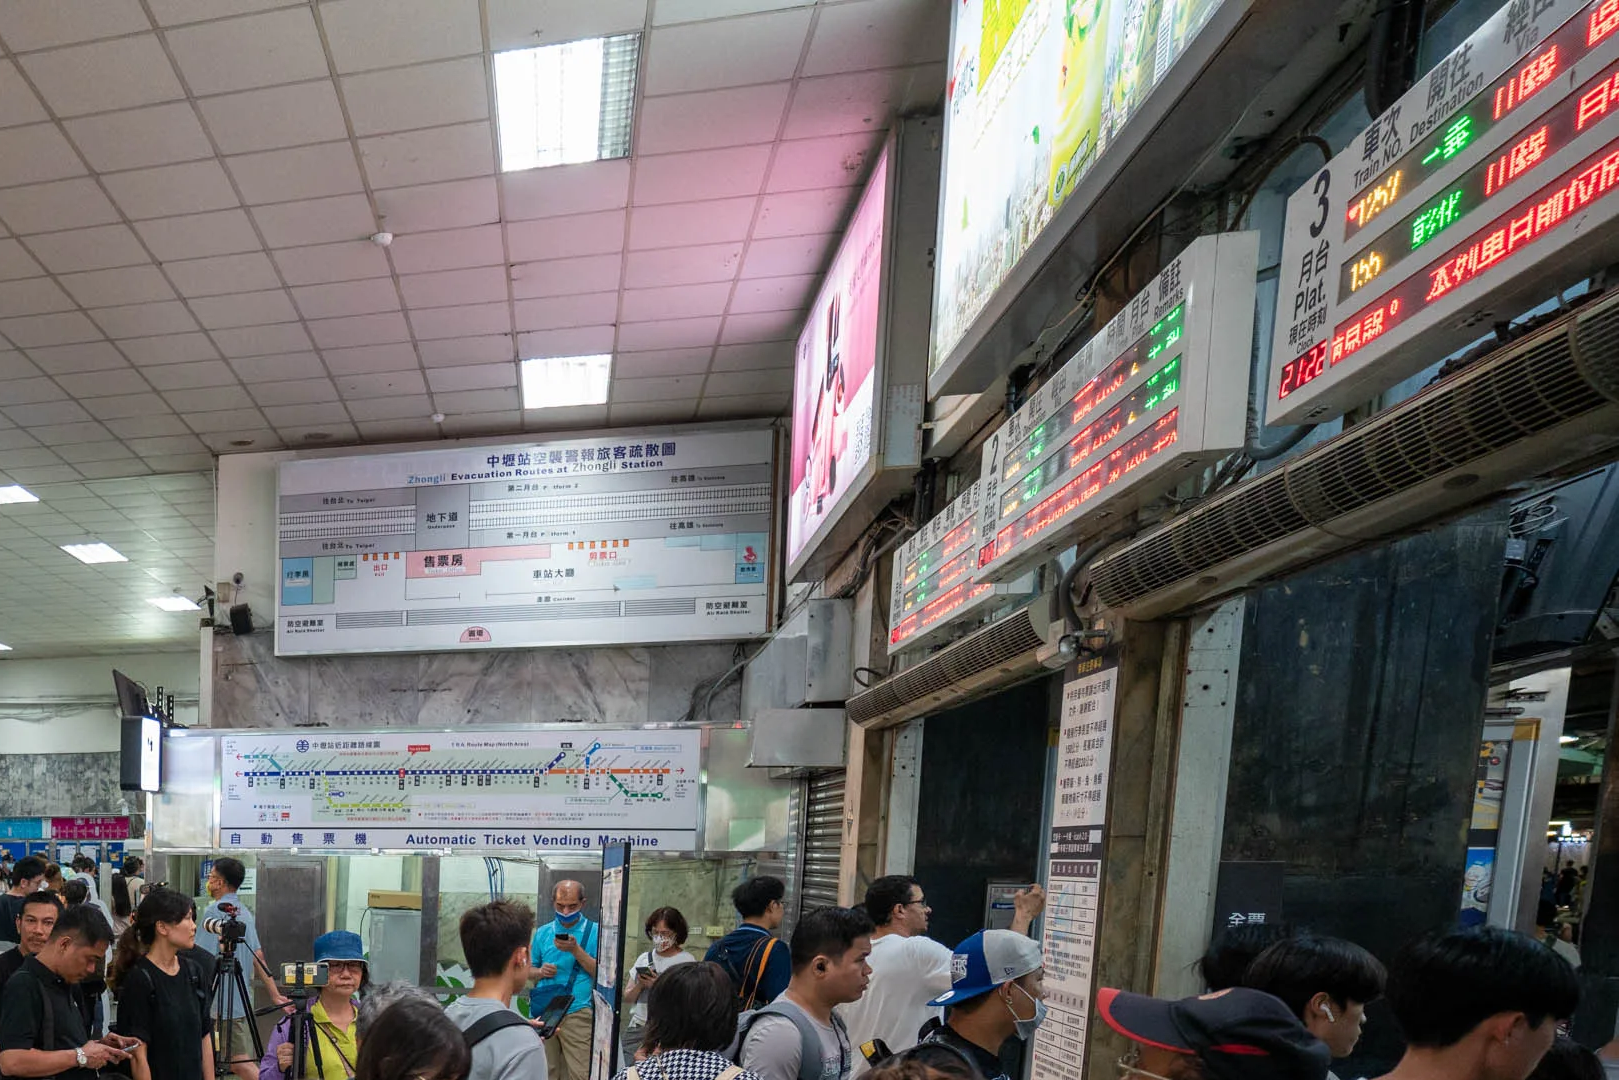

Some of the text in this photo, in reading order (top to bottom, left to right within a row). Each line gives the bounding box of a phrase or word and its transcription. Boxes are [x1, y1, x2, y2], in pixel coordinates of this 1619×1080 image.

[1516, 26, 1539, 55] Via
[1425, 43, 1472, 111] 開往
[1410, 72, 1483, 143] Destination
[1362, 104, 1401, 161] 車次
[1354, 139, 1403, 188] Train NO.
[1309, 169, 1332, 239] 3
[1300, 239, 1330, 289] 月台
[1154, 287, 1184, 321] Remarks
[1294, 282, 1327, 320] Plat.
[1280, 343, 1326, 400] 21:22
[486, 442, 676, 468] 中壢站空襲警報旅客疏散圖
[990, 433, 999, 476] 2
[407, 459, 663, 485] Zhongli Evacuation Routes at Zhongli Station
[426, 511, 458, 522] 地下道
[373, 563, 388, 571] 出口
[424, 554, 463, 568] 售票房
[532, 568, 575, 579] 車站大廳
[286, 570, 309, 579] 行李房
[706, 600, 748, 610] 防空避難室
[287, 619, 324, 628] 防空避難室
[312, 740, 381, 749] 中壢站近距離路線圖
[231, 832, 367, 845] 自動售票機
[406, 834, 476, 846] Automatic
[484, 834, 526, 845] Ticket
[533, 833, 590, 848] Vending
